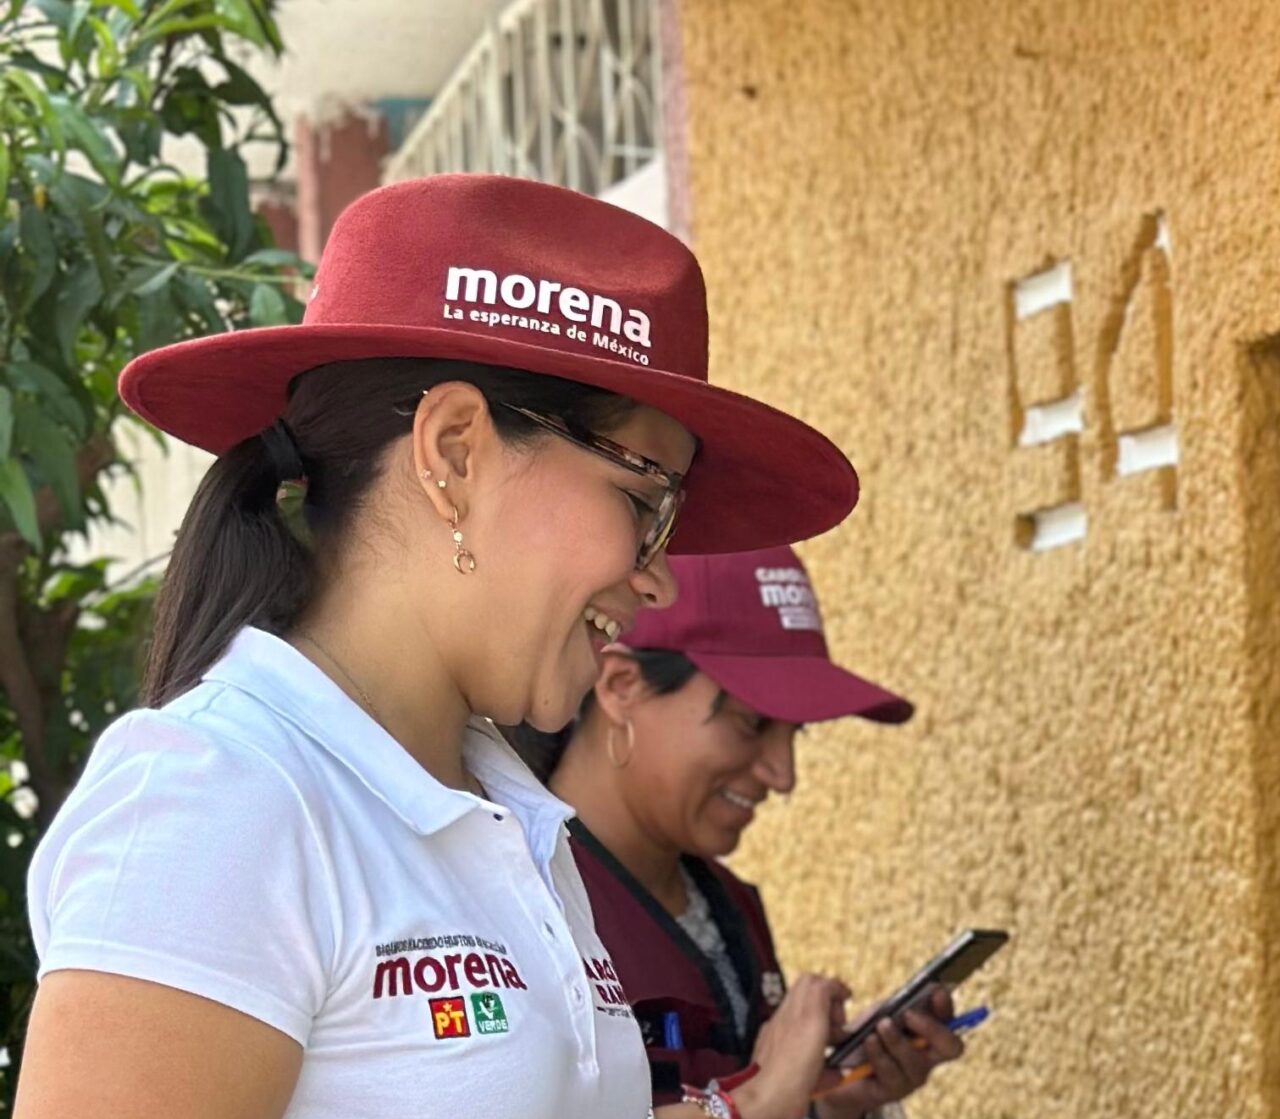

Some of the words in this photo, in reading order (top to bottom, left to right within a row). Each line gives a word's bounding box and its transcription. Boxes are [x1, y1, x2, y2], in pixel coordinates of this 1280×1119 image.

[444, 266, 652, 348] morena
[443, 304, 464, 320] La
[469, 308, 561, 336] esperanza
[566, 324, 587, 342] de
[592, 332, 650, 366] México
[373, 952, 528, 999] morena
[435, 1010, 464, 1036] PT
[478, 1018, 508, 1033] VERDE
